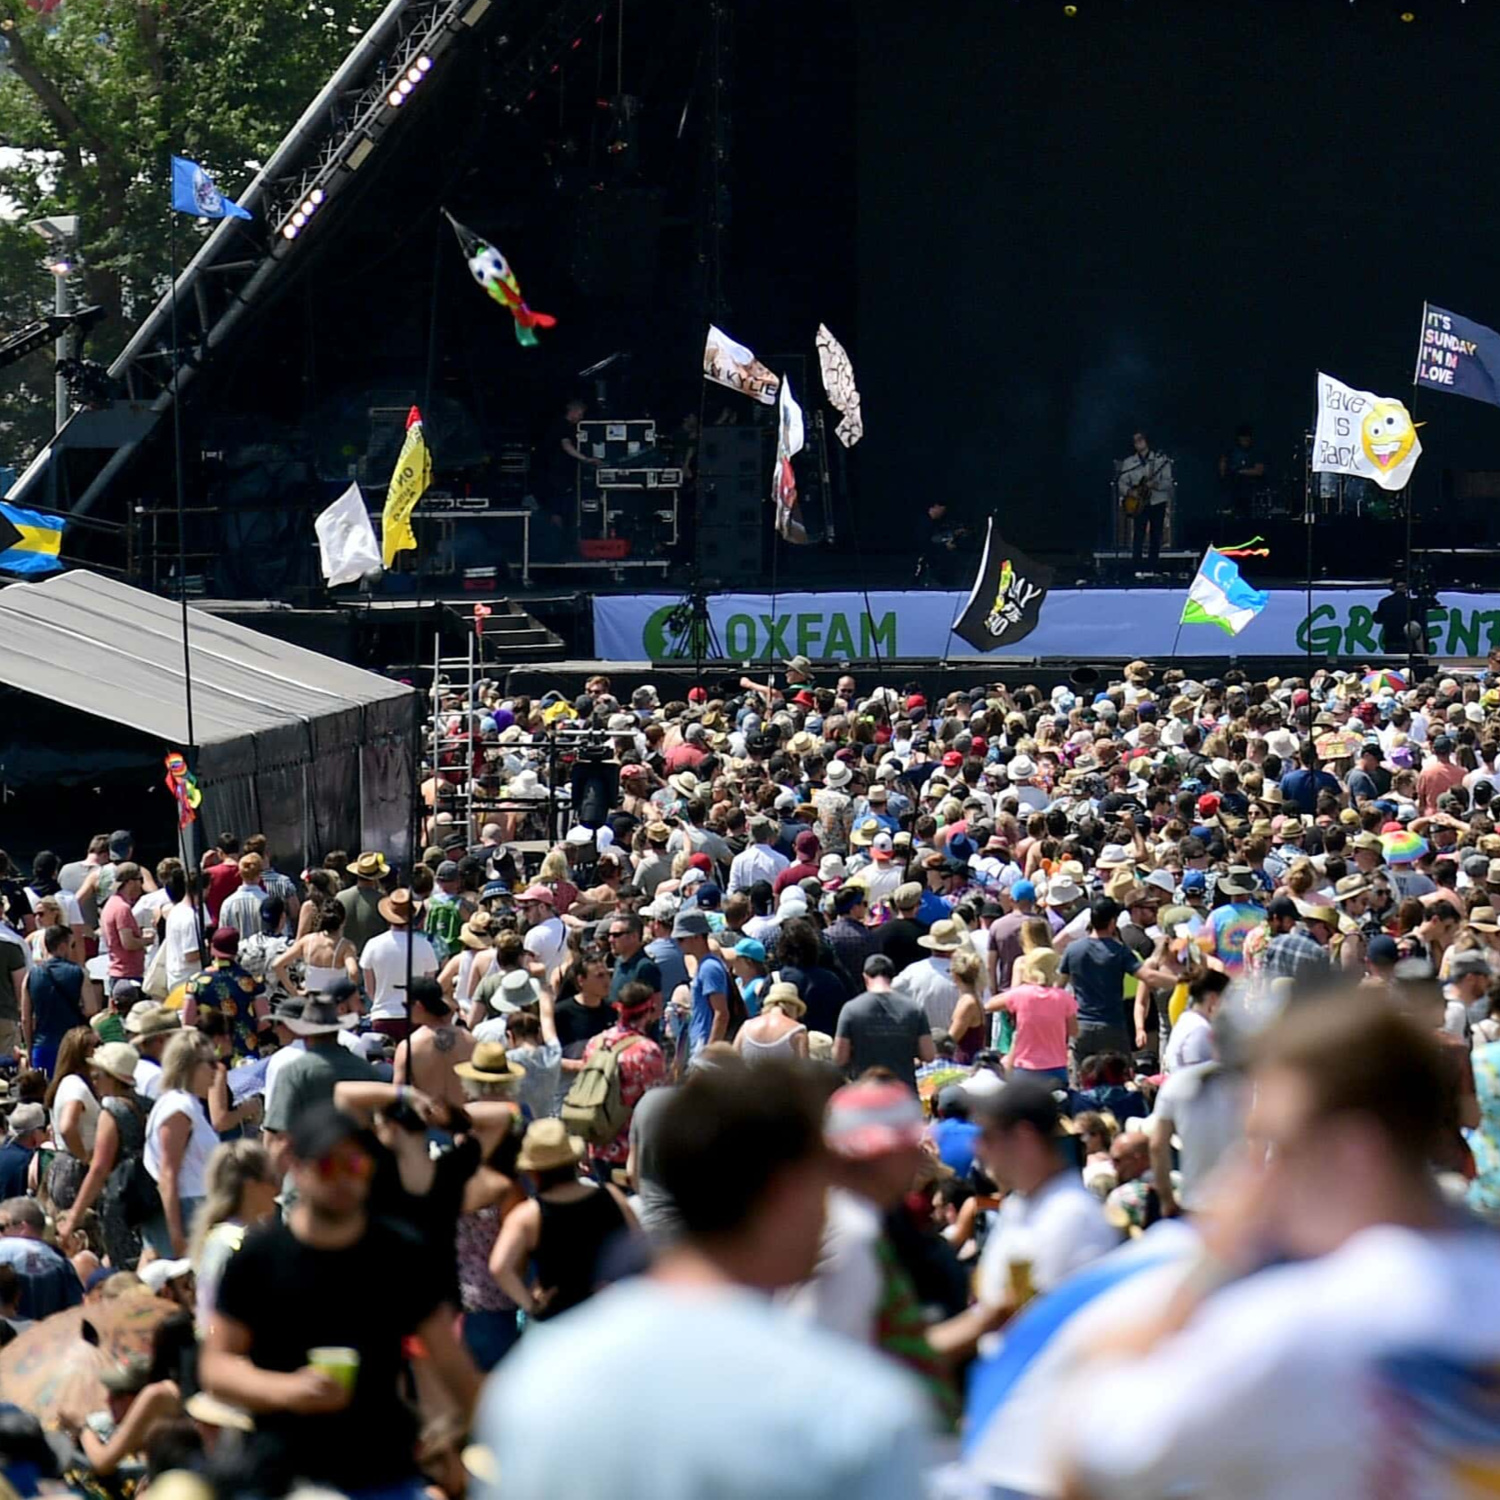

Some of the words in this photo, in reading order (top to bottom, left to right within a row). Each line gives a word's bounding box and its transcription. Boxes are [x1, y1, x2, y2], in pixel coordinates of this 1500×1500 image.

[1427, 312, 1451, 330] IT'S
[1424, 329, 1477, 356] SUNDAY
[1423, 346, 1444, 365] I'M
[1445, 352, 1458, 368] IN
[726, 369, 776, 396] KYLIE
[1420, 363, 1454, 385] LOVE
[725, 611, 896, 659] OXFAM
